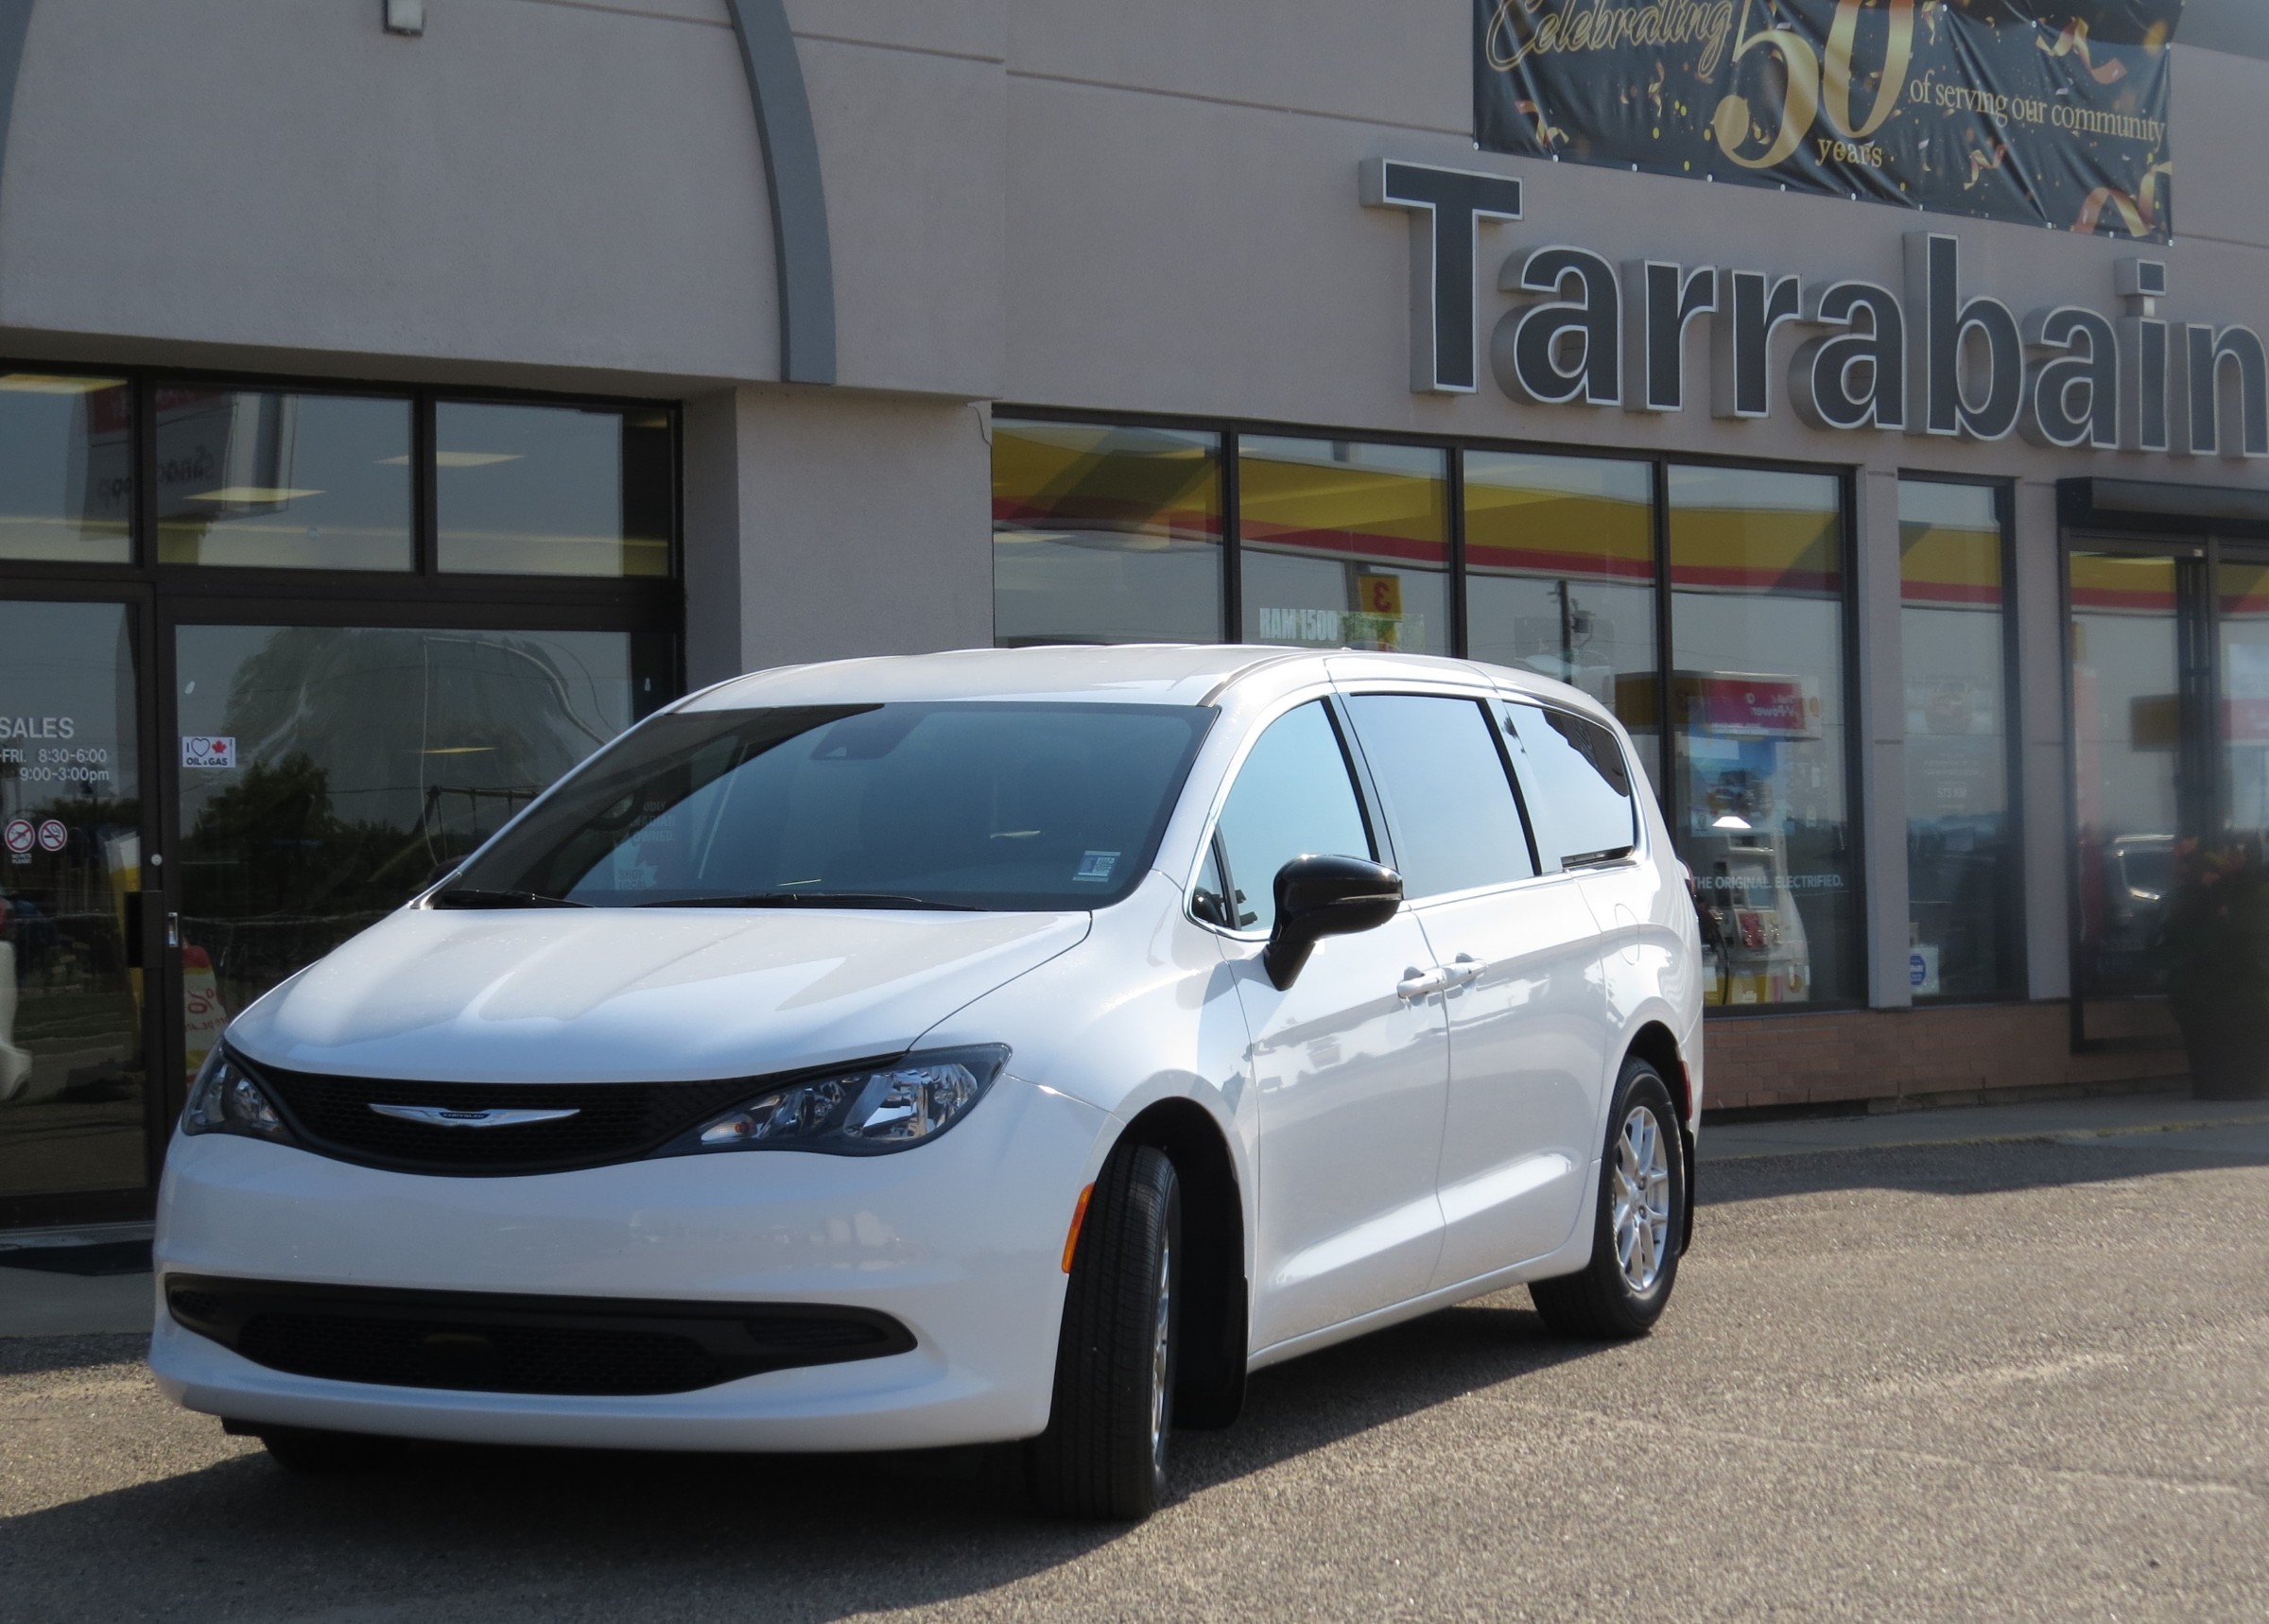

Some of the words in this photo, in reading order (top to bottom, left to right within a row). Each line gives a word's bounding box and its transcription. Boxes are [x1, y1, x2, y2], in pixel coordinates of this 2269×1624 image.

[1486, 0, 1732, 78] Celebrating
[1714, 0, 1914, 168] 50
[1910, 70, 1935, 104] of
[1935, 82, 2008, 128] serving
[2012, 96, 2048, 124] our
[2051, 104, 2167, 153] community
[1815, 138, 1882, 167] years
[1376, 158, 2269, 458] Tarrabain
[1259, 607, 1297, 640] RAM
[1300, 609, 1339, 641] 1500
[0, 717, 75, 738] SALES
[39, 749, 107, 763] 8:30-6:00
[186, 757, 201, 766] OIL
[208, 757, 228, 766] GAS
[19, 767, 110, 784] 9:00-3:00pm
[1692, 875, 1713, 890] THE
[1775, 874, 1845, 890] ELECTRIFIED.
